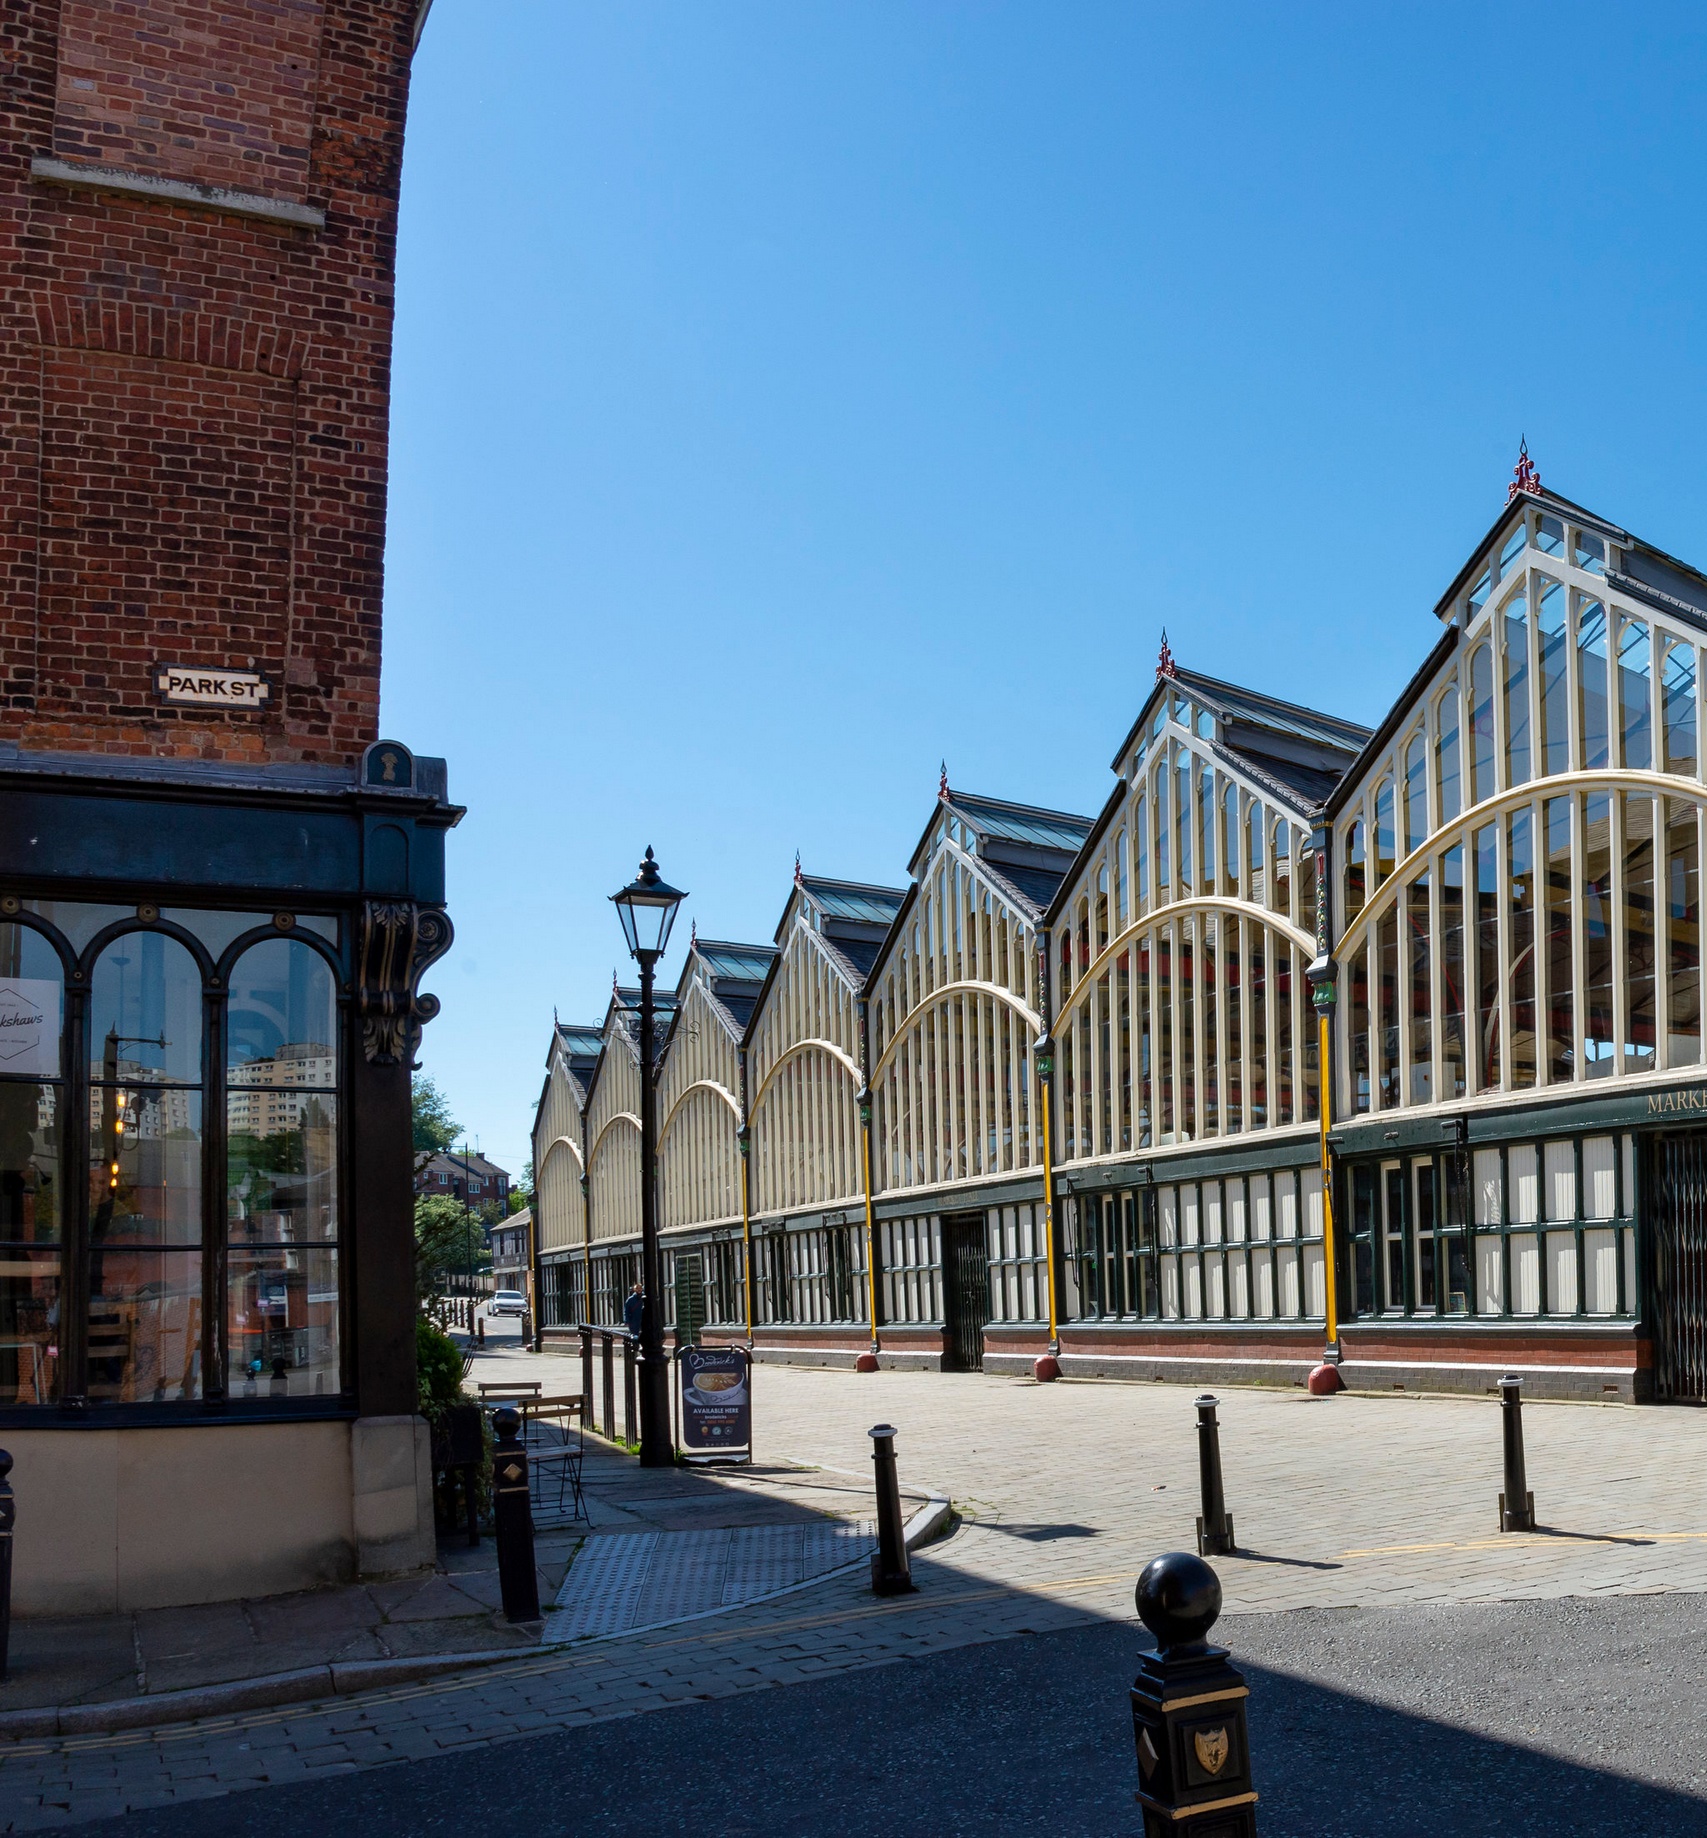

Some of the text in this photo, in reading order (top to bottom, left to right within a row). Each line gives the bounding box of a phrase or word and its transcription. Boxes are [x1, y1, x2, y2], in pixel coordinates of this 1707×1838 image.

[169, 677, 259, 697] PARK ST
[0, 1012, 43, 1027] kshaws
